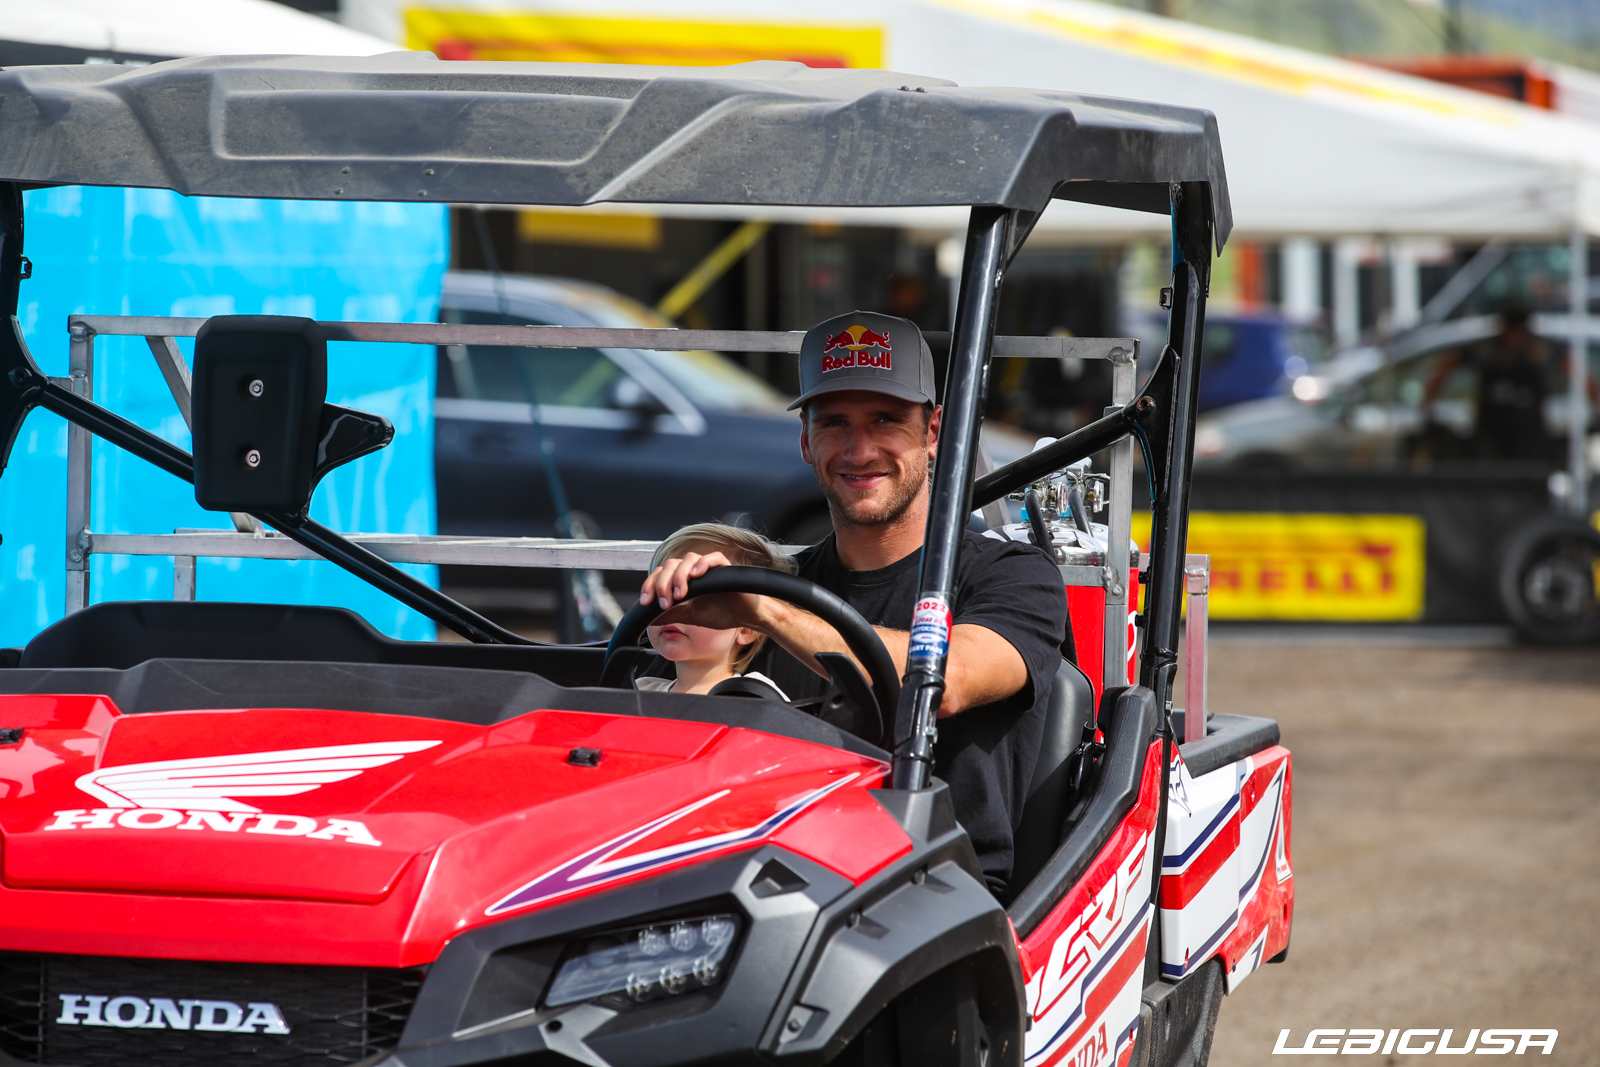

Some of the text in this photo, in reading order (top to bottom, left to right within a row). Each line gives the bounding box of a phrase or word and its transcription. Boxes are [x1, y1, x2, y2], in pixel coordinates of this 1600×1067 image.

[822, 350, 892, 373] Red Bull
[916, 601, 946, 612] 2022
[44, 808, 382, 847] HONDA
[56, 994, 291, 1034] HONDA
